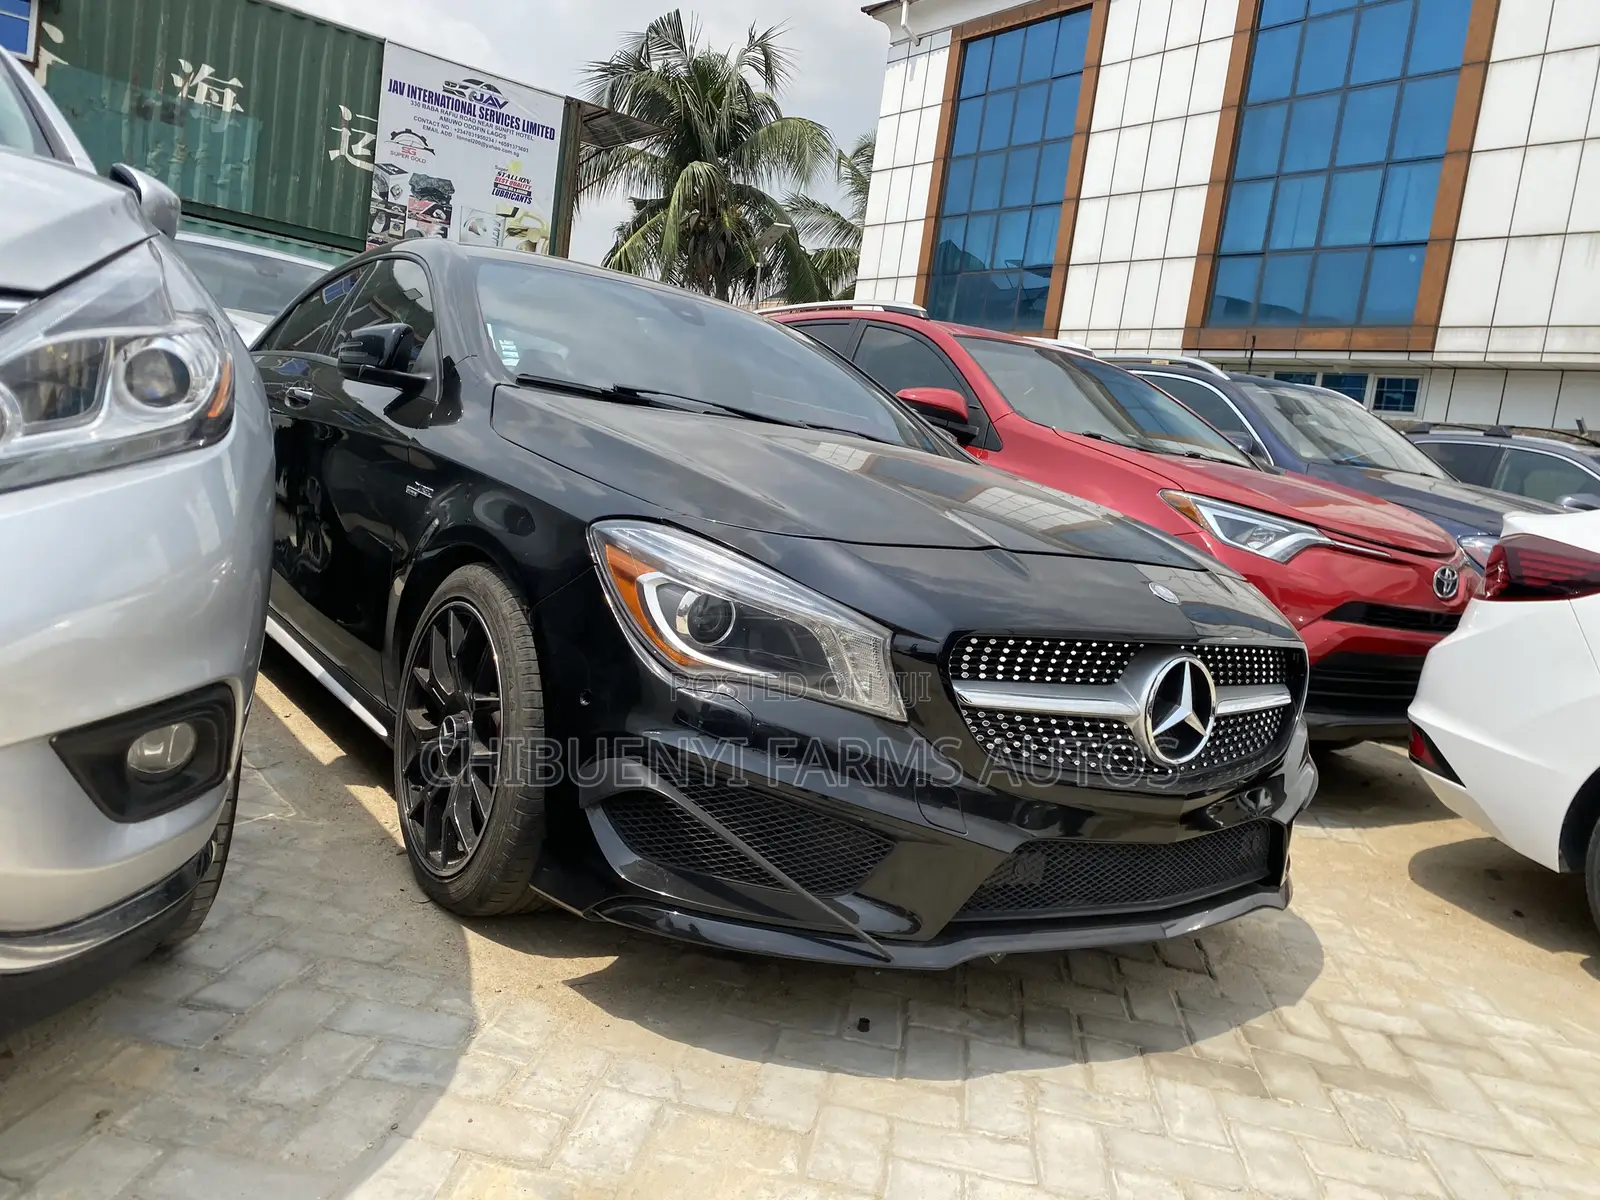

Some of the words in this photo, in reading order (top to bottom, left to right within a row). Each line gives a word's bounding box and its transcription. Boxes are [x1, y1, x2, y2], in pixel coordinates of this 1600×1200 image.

[388, 79, 405, 96] JAV
[407, 84, 477, 117] INTERNATIONAL
[479, 106, 520, 130] SERVICES
[522, 119, 555, 140] LIMITED
[413, 116, 440, 127] CONTACT
[422, 103, 439, 113] BABA
[460, 115, 476, 124] ROAD
[478, 120, 493, 129] NEAR
[516, 131, 534, 141] HOTEL
[423, 125, 439, 133] EMAIL
[439, 116, 463, 127] AMUWO
[464, 121, 485, 134] ODOFIN
[487, 128, 507, 140] LAGOS
[390, 150, 409, 159] SUPER
[410, 155, 426, 164] GOLD
[497, 171, 531, 184] STALLION
[492, 188, 532, 204] LUBRICANTS
